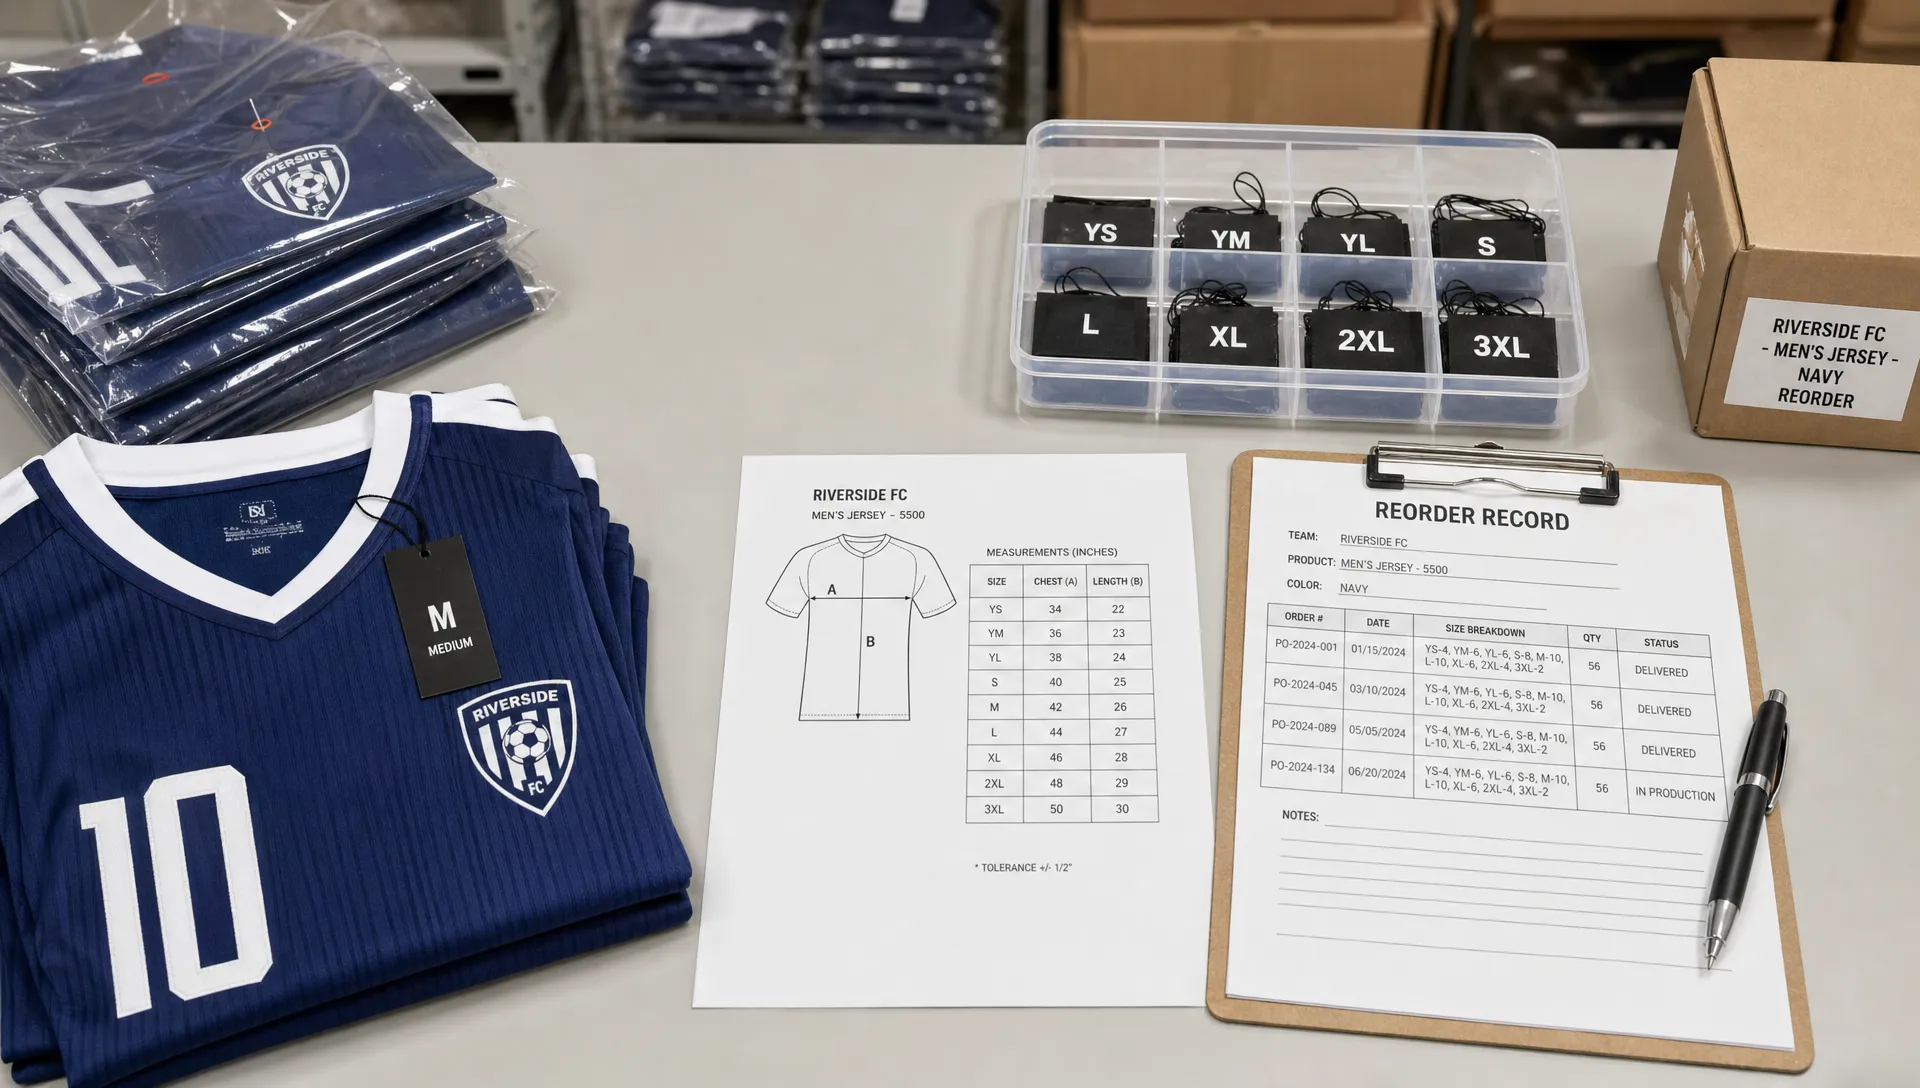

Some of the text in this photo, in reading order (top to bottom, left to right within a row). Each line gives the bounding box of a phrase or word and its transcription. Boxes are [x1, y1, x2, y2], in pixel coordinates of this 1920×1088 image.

[255, 149, 330, 182] RIVERSIDE
[312, 203, 326, 212] FC
[1084, 222, 1117, 243] YS
[1211, 230, 1250, 250] YM
[1340, 233, 1376, 253] YL
[1478, 236, 1496, 256] S
[1083, 313, 1099, 335] L
[1773, 318, 1886, 342] RIVERSIDE FC
[1209, 325, 1247, 348] XL
[1338, 329, 1395, 353] 2XL
[1474, 335, 1530, 359] 3XL
[1827, 347, 1889, 366] JERSEY
[1798, 367, 1844, 385] NAVY
[1778, 387, 1854, 409] REORDER
[813, 488, 907, 501] RIVERSIDE FC
[812, 511, 844, 520] MEN'S
[847, 511, 886, 520] JERSEY
[900, 510, 925, 519] 5500
[1376, 501, 1569, 531] REORDER RECORD
[1288, 530, 1408, 548] TEAM: RIVERSIDE FC
[987, 548, 1118, 558] MEASUREMENTS (INCHES)
[1288, 554, 1336, 567] PRODUCT:
[1341, 558, 1373, 570] MEN'S
[1375, 561, 1413, 572] JERSEY
[1423, 564, 1448, 575] 5500
[987, 577, 1006, 586] SIZE
[1034, 577, 1078, 587] CHEST (A)
[1093, 577, 1143, 587] LENGTH (B)
[1287, 579, 1368, 594] COLOR: NAVY
[827, 584, 837, 595] A
[989, 605, 1002, 614] YS
[1049, 605, 1062, 614] 34
[1112, 604, 1125, 614] 22
[427, 601, 457, 632] M
[1285, 612, 1315, 622] ORDER
[1367, 618, 1390, 628] DATE
[988, 629, 1004, 638] YM
[1049, 628, 1062, 638] 36
[1112, 628, 1125, 638] 23
[1445, 624, 1525, 638] SIZE BREAKDOWN
[866, 636, 875, 647] B
[1583, 633, 1601, 643] QTY
[1644, 638, 1679, 648] STATUS
[428, 636, 473, 656] MEDIUM
[1275, 638, 1337, 651] PO-2024-001
[1351, 644, 1406, 657] 01/15/2024
[989, 653, 1001, 662] YL
[1049, 652, 1062, 662] 38
[1113, 652, 1126, 662] 24
[1425, 644, 1564, 664] YS-4, YM-6, YL-6, S-8, M-10,
[1425, 657, 1544, 674] L-10, XL-6, 2XL-4, 3XL-2
[1588, 661, 1601, 671] 56
[1635, 665, 1688, 678] DELIVERED
[991, 677, 998, 687] S
[1049, 677, 1062, 687] 40
[1114, 677, 1127, 687] 25
[1274, 678, 1338, 692] PO-2024-045
[1350, 683, 1406, 697] 03/10/2024
[1425, 683, 1566, 703] YS-4, YM-6, YL-6, S-8, M-10,
[472, 689, 559, 722] RIVERSIDE
[990, 703, 999, 712] M
[1049, 702, 1062, 712] 42
[1114, 702, 1127, 712] 26
[1425, 696, 1546, 714] L-10, XL-6, 2XL-4, 3XL-2
[1591, 700, 1603, 710] 56
[1638, 704, 1692, 717] DELIVERED
[1050, 727, 1063, 737] 44
[1115, 727, 1127, 737] 27
[1272, 719, 1337, 733] PO-2024-089
[1349, 724, 1406, 738] 05/05/2024
[991, 728, 997, 737] L
[1425, 724, 1568, 744] YS-4, YM-6, YL-6, S-8, M-10,
[1425, 737, 1548, 755] L-10, XL-6, 2XL-4, 3XL-2
[1593, 741, 1606, 751] 56
[1641, 745, 1696, 758] DELIVERED
[988, 753, 1001, 763] XL
[1050, 753, 1063, 762] 46
[1115, 752, 1128, 762] 28
[1271, 760, 1335, 774] PO-2024-134
[1348, 766, 1406, 779] 06/20/2024
[1425, 766, 1570, 786] YS-4, YM-6, YL-6, S-8, M-10,
[527, 780, 545, 796] FC
[985, 778, 1004, 789] 2XL
[1050, 778, 1063, 788] 48
[1115, 778, 1128, 788] 29
[1425, 779, 1549, 797] L-10, XL-6, 2XL-4, 3XL-2
[1596, 783, 1609, 793] 56
[1636, 786, 1716, 802] IN PRODUCTION
[984, 804, 1004, 814] 3XL
[1050, 804, 1063, 814] 50
[1116, 804, 1129, 814] 30
[1282, 810, 1319, 822] NOTES:
[981, 863, 1036, 872] TOLERANCE
[1039, 863, 1051, 872] +/-
[78, 764, 274, 1020] 10
